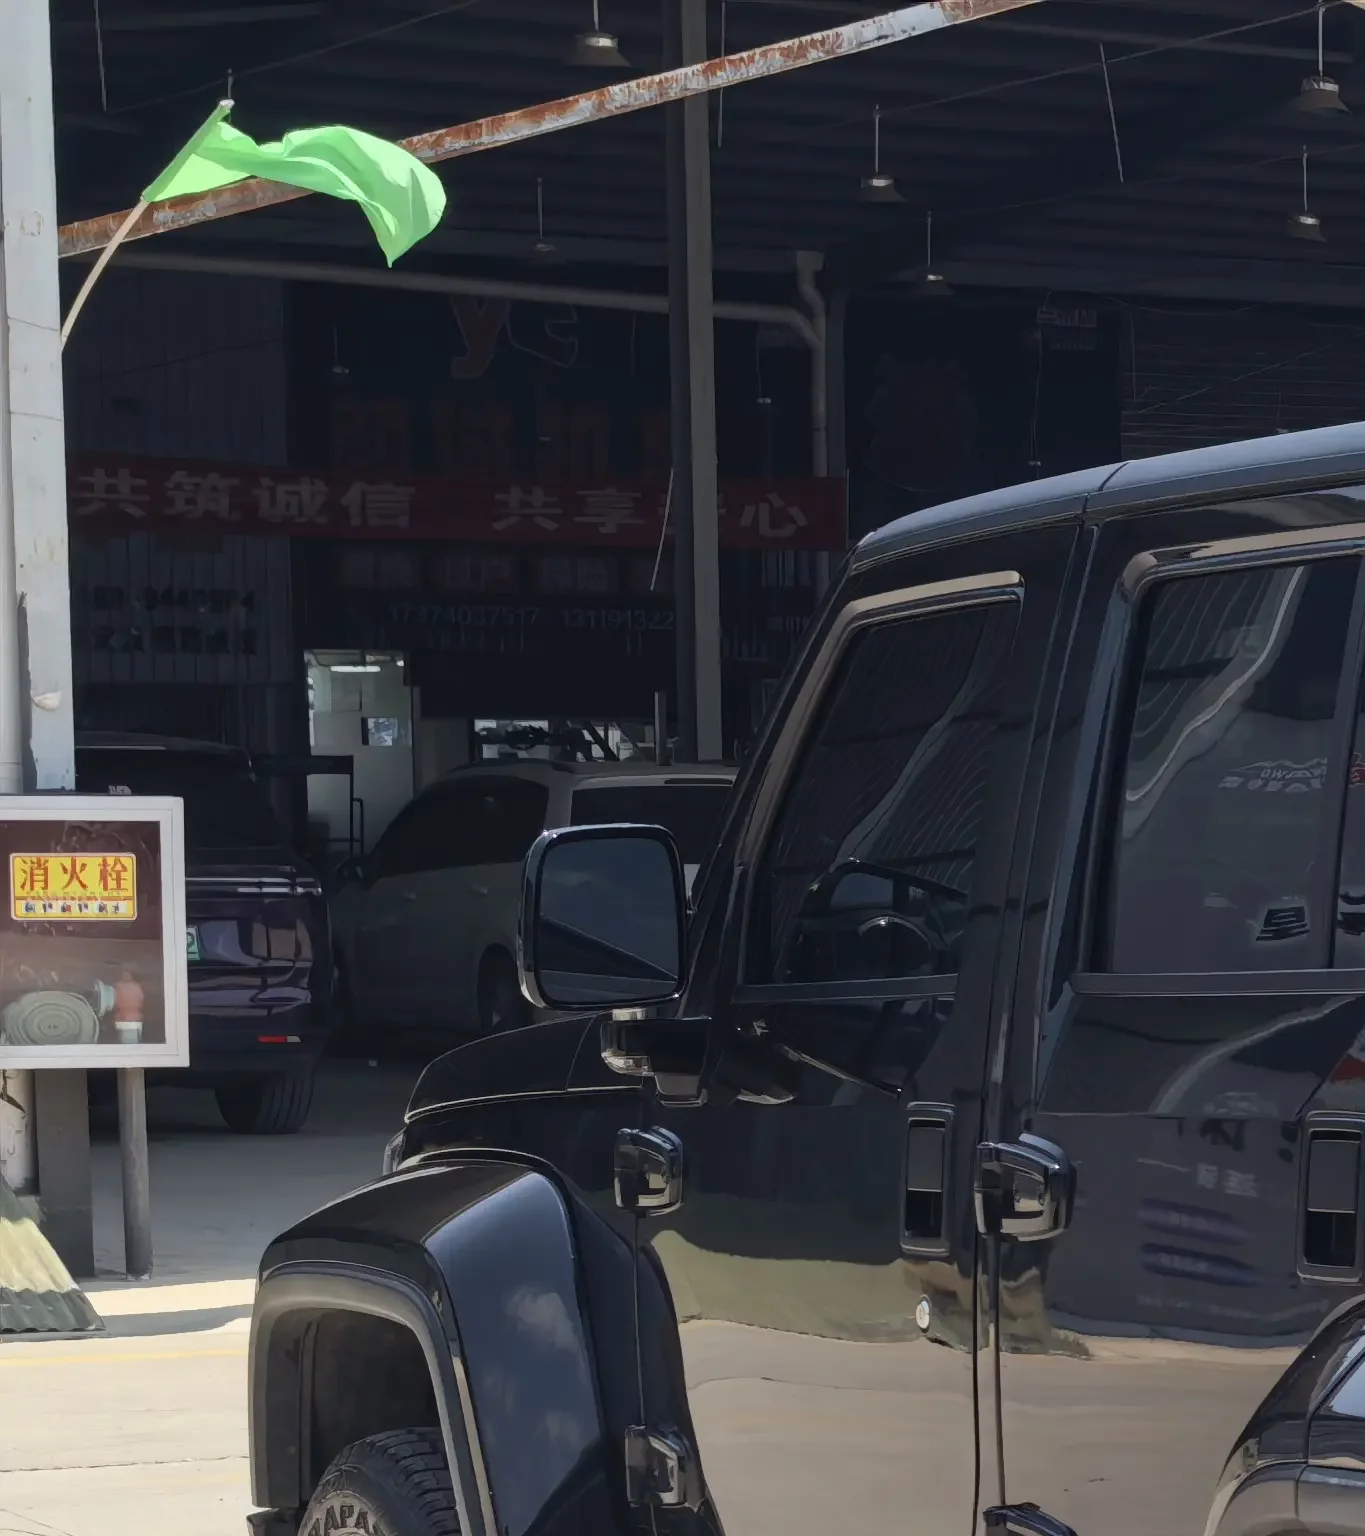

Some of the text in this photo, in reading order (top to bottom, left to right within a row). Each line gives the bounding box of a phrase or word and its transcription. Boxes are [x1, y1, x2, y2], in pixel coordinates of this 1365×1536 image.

[74, 468, 415, 528] 共筑诚信
[19, 855, 129, 892] 消火栓
